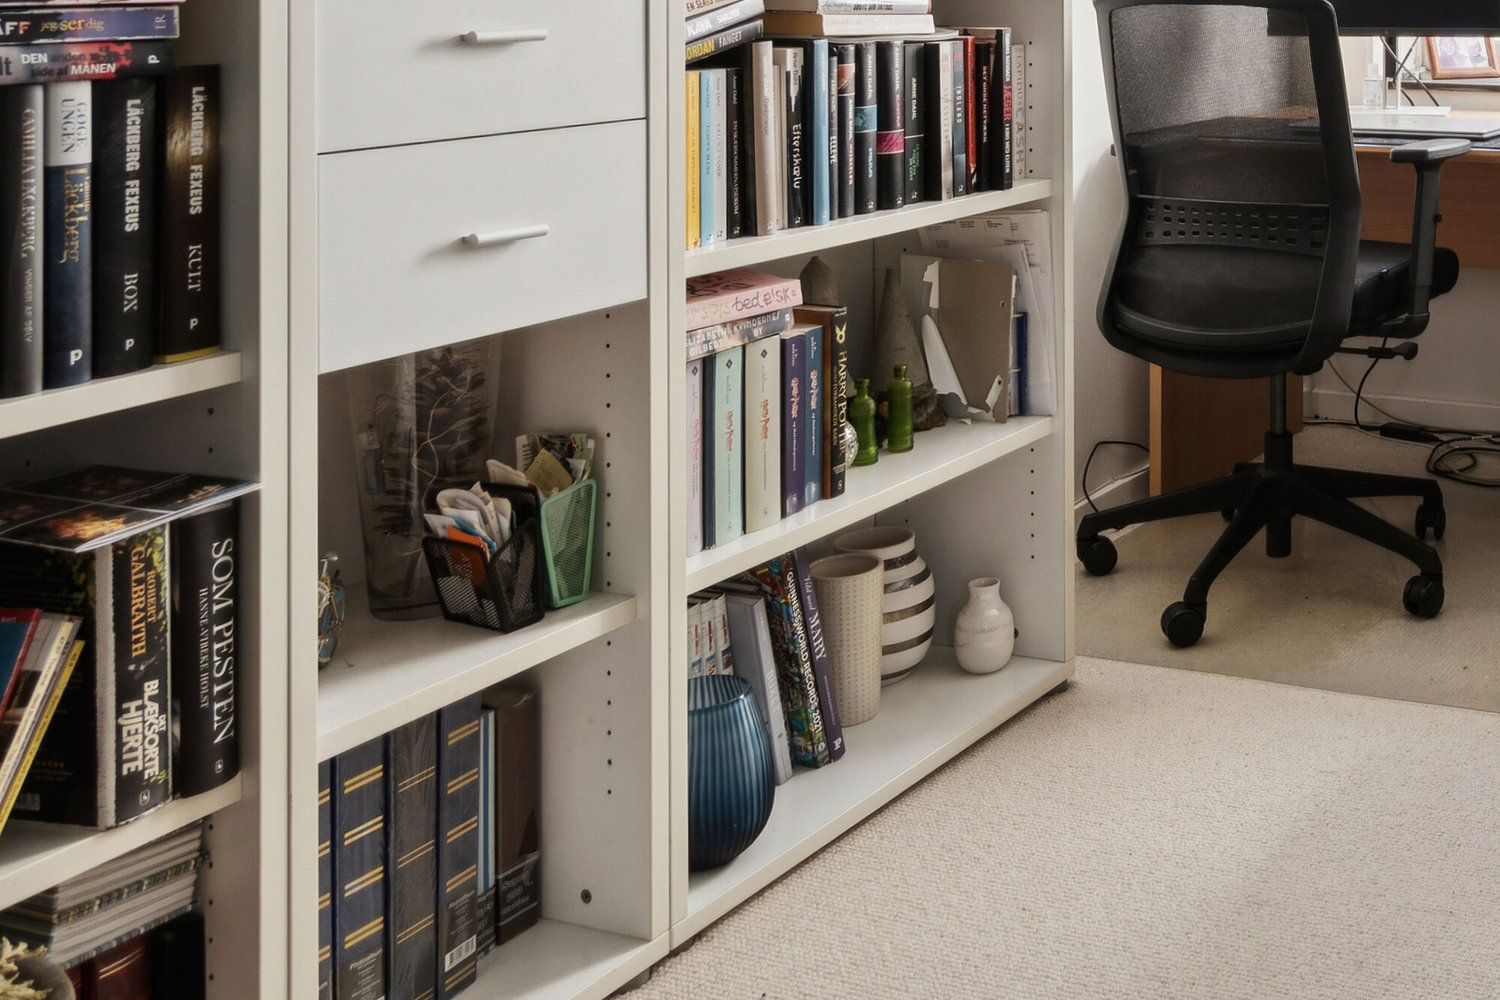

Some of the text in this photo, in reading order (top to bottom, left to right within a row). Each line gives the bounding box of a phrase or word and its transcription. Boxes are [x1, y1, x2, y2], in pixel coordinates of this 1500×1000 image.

[40, 18, 105, 32] jeg ser dig
[686, 2, 696, 12] EN
[20, 53, 48, 65] DEN
[686, 30, 743, 60] ORDAN FANGET
[866, 77, 874, 100] DAHL
[956, 86, 964, 124] INDLAND
[1003, 84, 1012, 121] JÆGER
[60, 98, 76, 154] UNGEN
[1015, 107, 1025, 164] CASH
[124, 98, 142, 233] LÄCKBERG FEXEUS
[189, 86, 206, 216] LÄCKBERG FEXEUS
[830, 135, 838, 164] ELLEVE
[58, 167, 89, 264] Läckberg
[188, 244, 202, 292] KULT
[123, 272, 139, 314] BOX
[685, 325, 727, 347] ELIZABETH
[733, 311, 780, 332] KVINDERNES
[753, 327, 763, 337] BY
[689, 339, 724, 357] GILBERT
[838, 350, 848, 400] HARRY
[131, 548, 147, 659] GALBRAITH
[146, 570, 156, 623] ROBERT
[211, 537, 234, 745] SOM PESTEN
[786, 571, 823, 734] GUINNESS WORLD RECORDS 2021
[808, 612, 827, 661] MARY
[117, 699, 144, 777] HJERTE
[143, 679, 160, 781] BLÆKSORTE
[158, 714, 166, 732] DET
